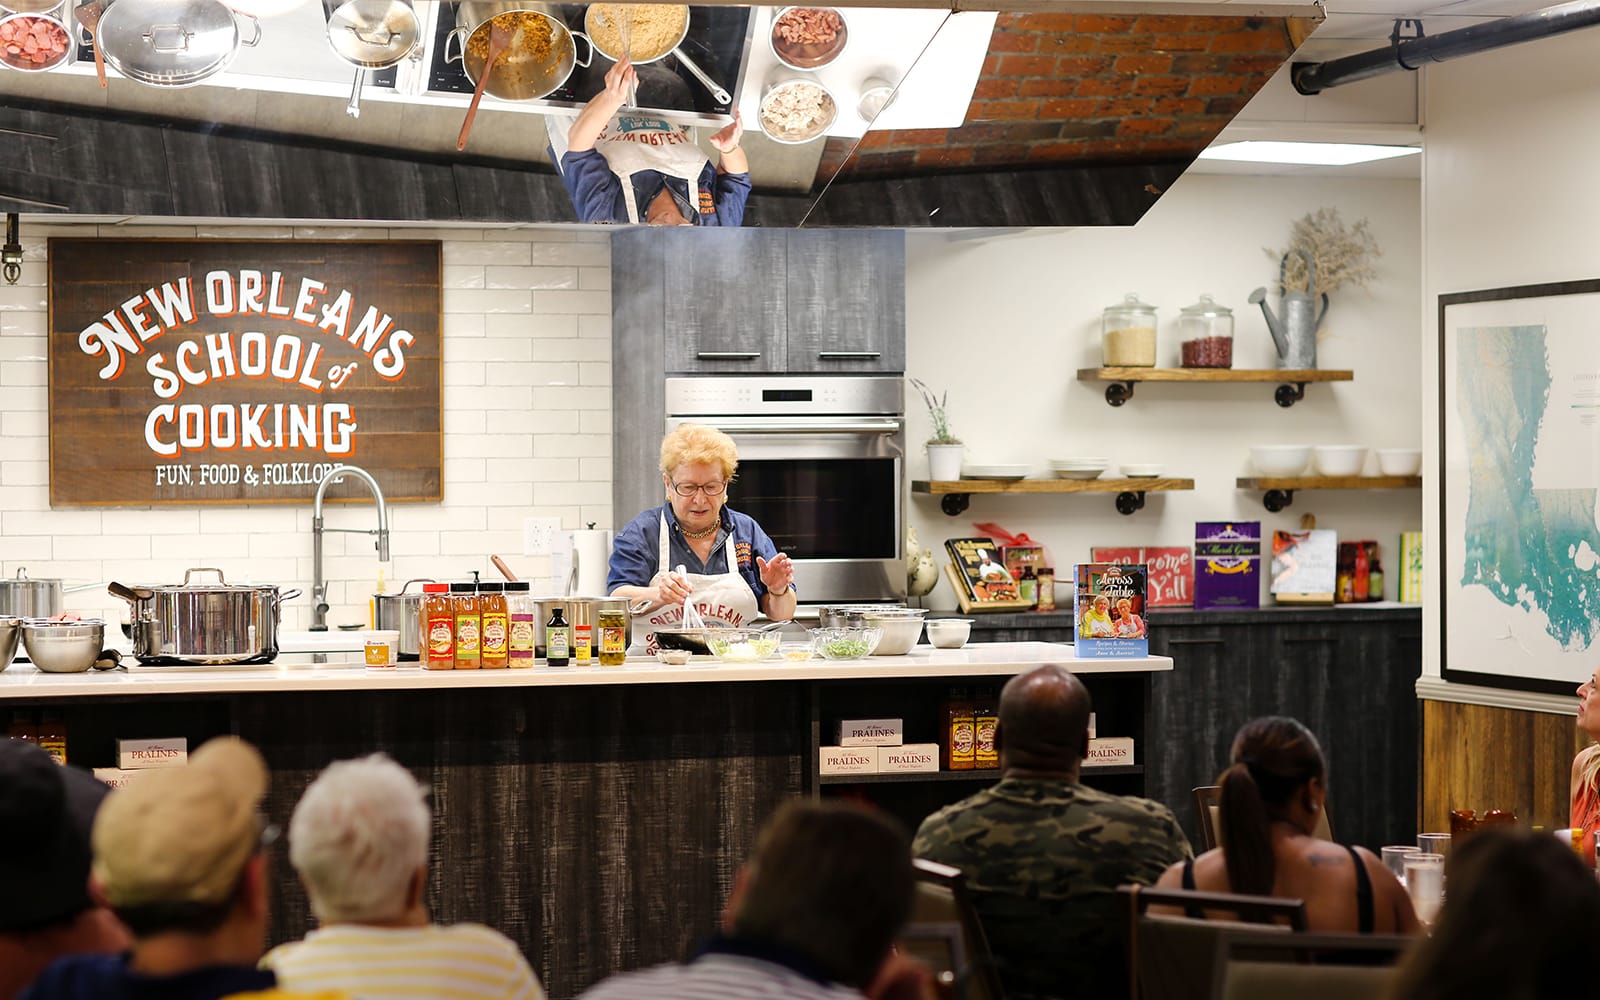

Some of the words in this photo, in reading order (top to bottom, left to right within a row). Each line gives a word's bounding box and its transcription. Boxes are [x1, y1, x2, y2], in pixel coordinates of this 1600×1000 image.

[78, 277, 198, 380] NEW
[205, 269, 415, 380] ORLEANS
[146, 332, 326, 399] SCHOOL
[327, 362, 358, 390] of
[145, 403, 357, 458] COOKING
[155, 464, 195, 486] FUN,
[199, 464, 240, 485] FOOD
[243, 465, 260, 487] &
[1096, 573, 1133, 586] Across
[1149, 571, 1187, 603] Y'all
[1104, 585, 1136, 598] Table
[650, 602, 684, 625] NEW
[693, 603, 742, 628] RLEAN
[852, 729, 895, 738] PRALINES
[131, 749, 179, 759] PRALINES
[827, 757, 871, 766] PRALINES
[888, 755, 932, 764] PRALINES
